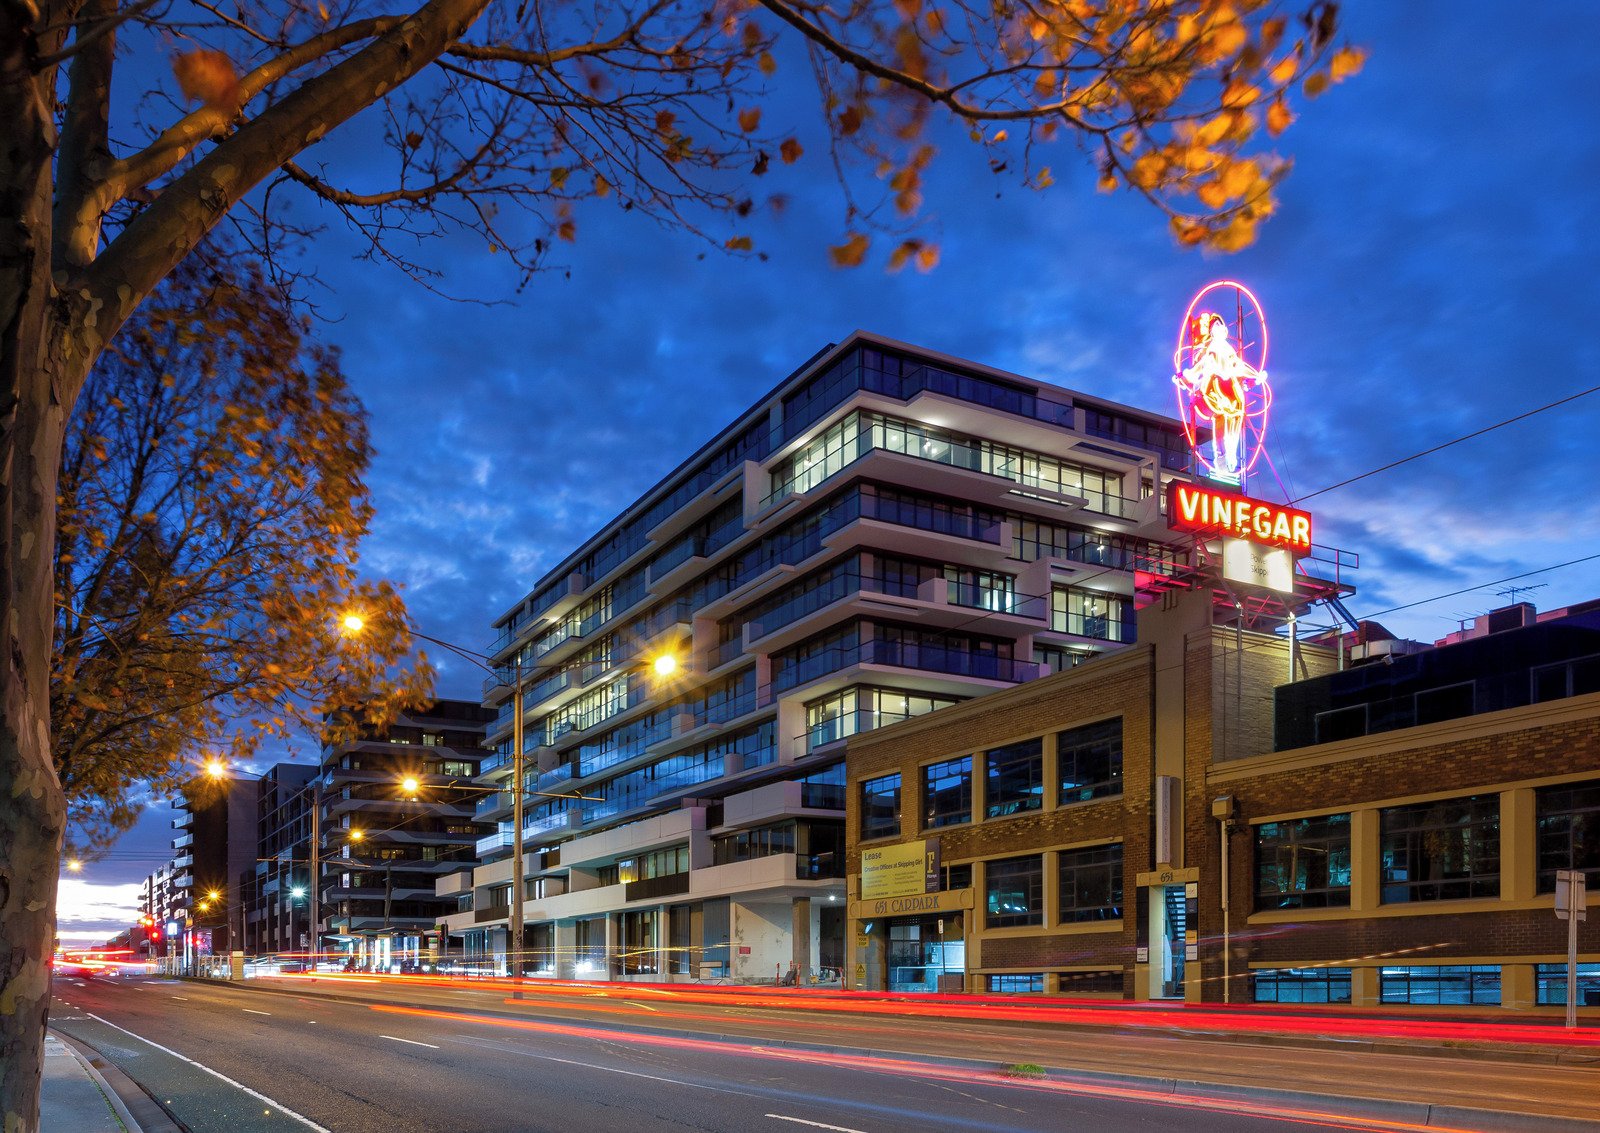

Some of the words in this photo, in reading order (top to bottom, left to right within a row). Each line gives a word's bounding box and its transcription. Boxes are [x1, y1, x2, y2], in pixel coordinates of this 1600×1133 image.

[1179, 488, 1310, 547] VINEGAR
[864, 852, 882, 861] Lease
[879, 863, 893, 871] Offices
[897, 860, 915, 868] Skipping
[1160, 872, 1173, 882] 651
[874, 902, 888, 914] 651
[891, 896, 940, 912] CARPARK
